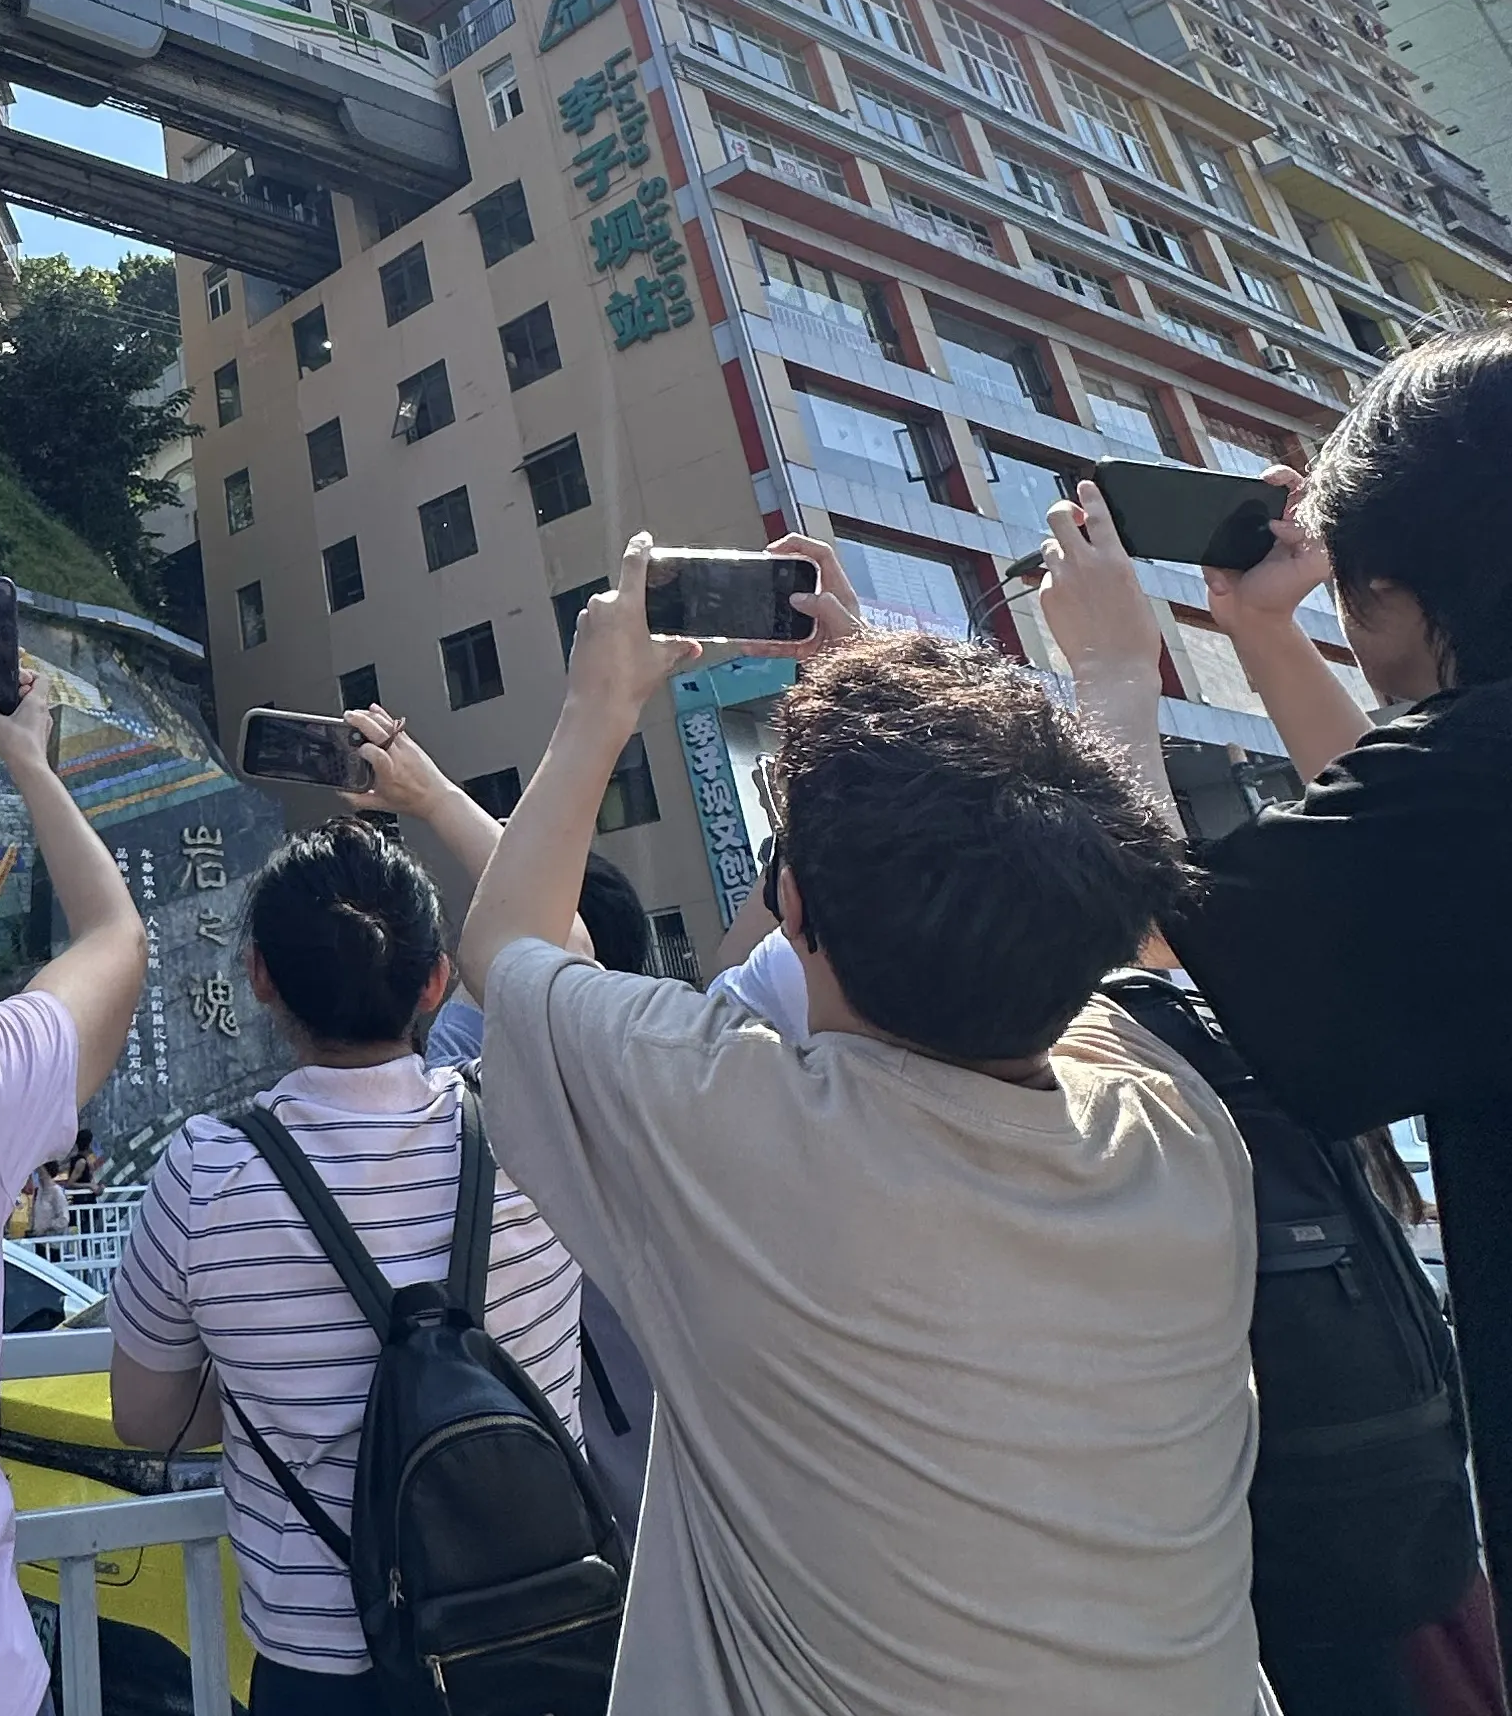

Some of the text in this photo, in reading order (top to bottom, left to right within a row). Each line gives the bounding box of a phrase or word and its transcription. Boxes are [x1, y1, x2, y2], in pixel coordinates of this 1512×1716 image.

[557, 70, 671, 352] 李子坝站
[637, 176, 695, 328] Station
